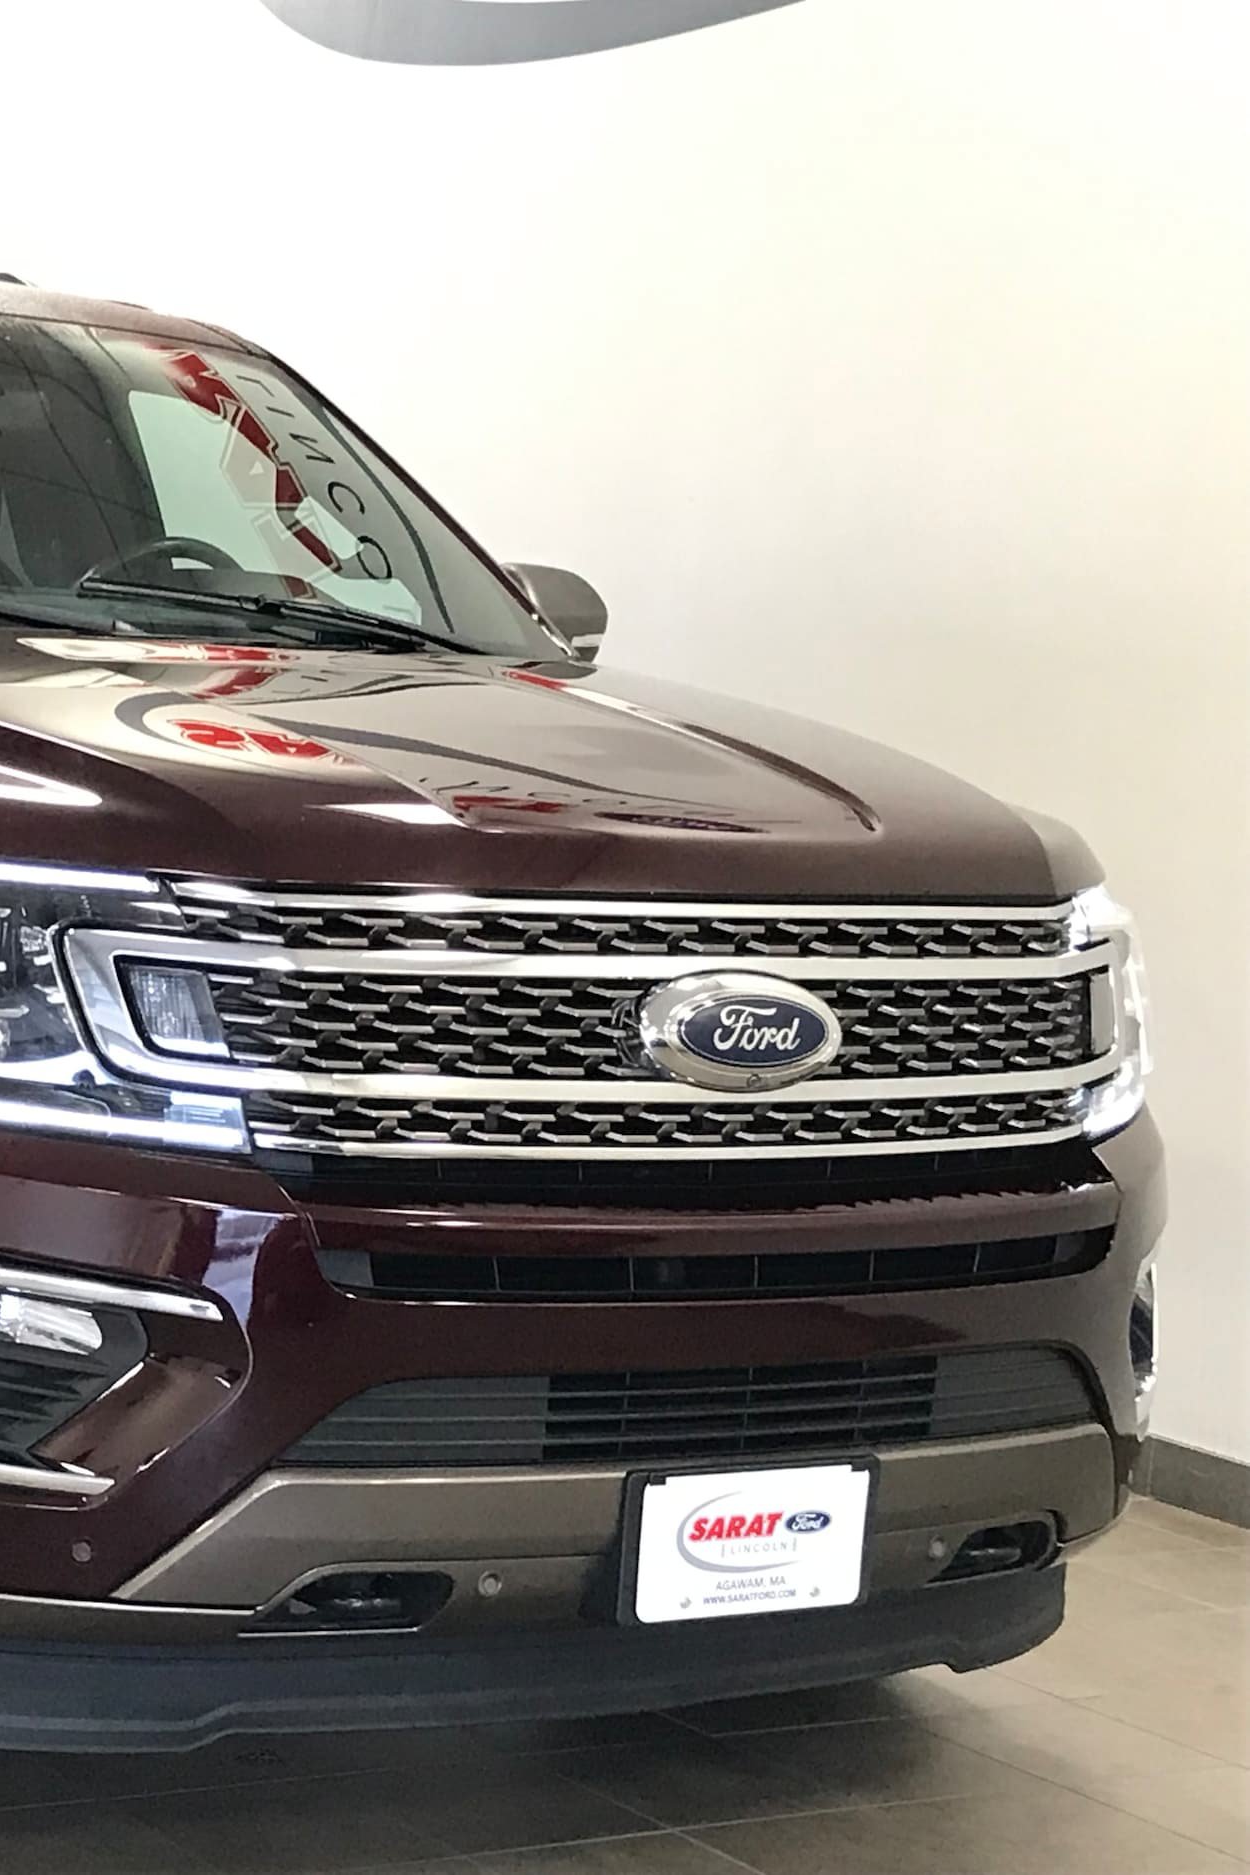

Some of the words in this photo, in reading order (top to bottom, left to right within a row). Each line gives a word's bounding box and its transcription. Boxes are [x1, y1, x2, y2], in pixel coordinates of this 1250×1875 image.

[713, 1004, 801, 1051] Ford
[688, 1512, 784, 1543] SARAT
[788, 1512, 826, 1532] Ford
[729, 1542, 788, 1556] LINCOLN
[769, 1575, 787, 1587] MA
